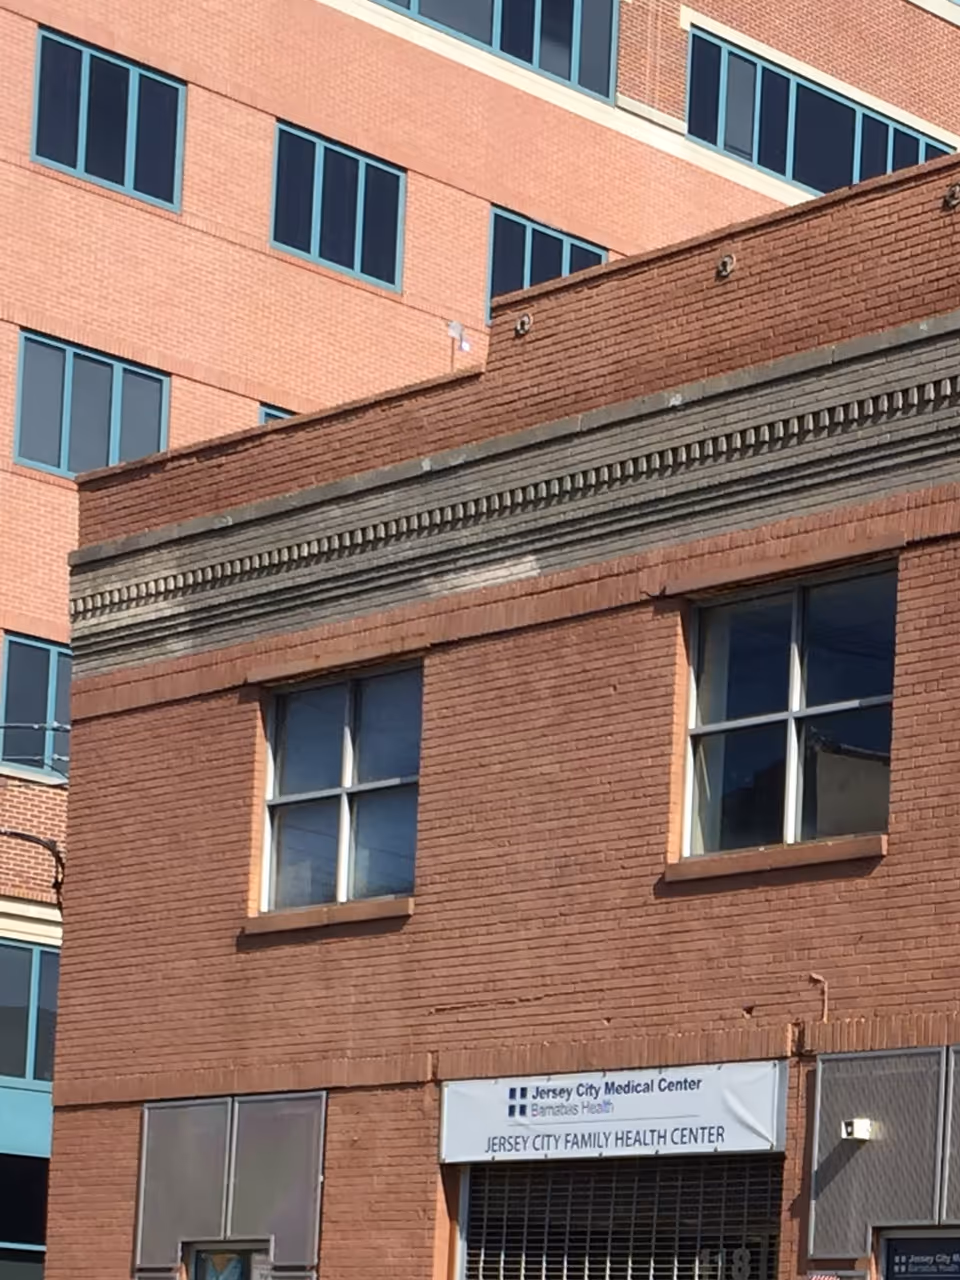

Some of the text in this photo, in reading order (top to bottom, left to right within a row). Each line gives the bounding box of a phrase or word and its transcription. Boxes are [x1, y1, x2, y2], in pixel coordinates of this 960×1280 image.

[532, 1076, 703, 1101] Jersey City Medical Center
[531, 1100, 614, 1117] Barnabas Health
[485, 1125, 725, 1154] JERSEY CITY FAMILY HEALTH CENTER
[908, 1254, 934, 1264] Jersey
[936, 1254, 951, 1264] City
